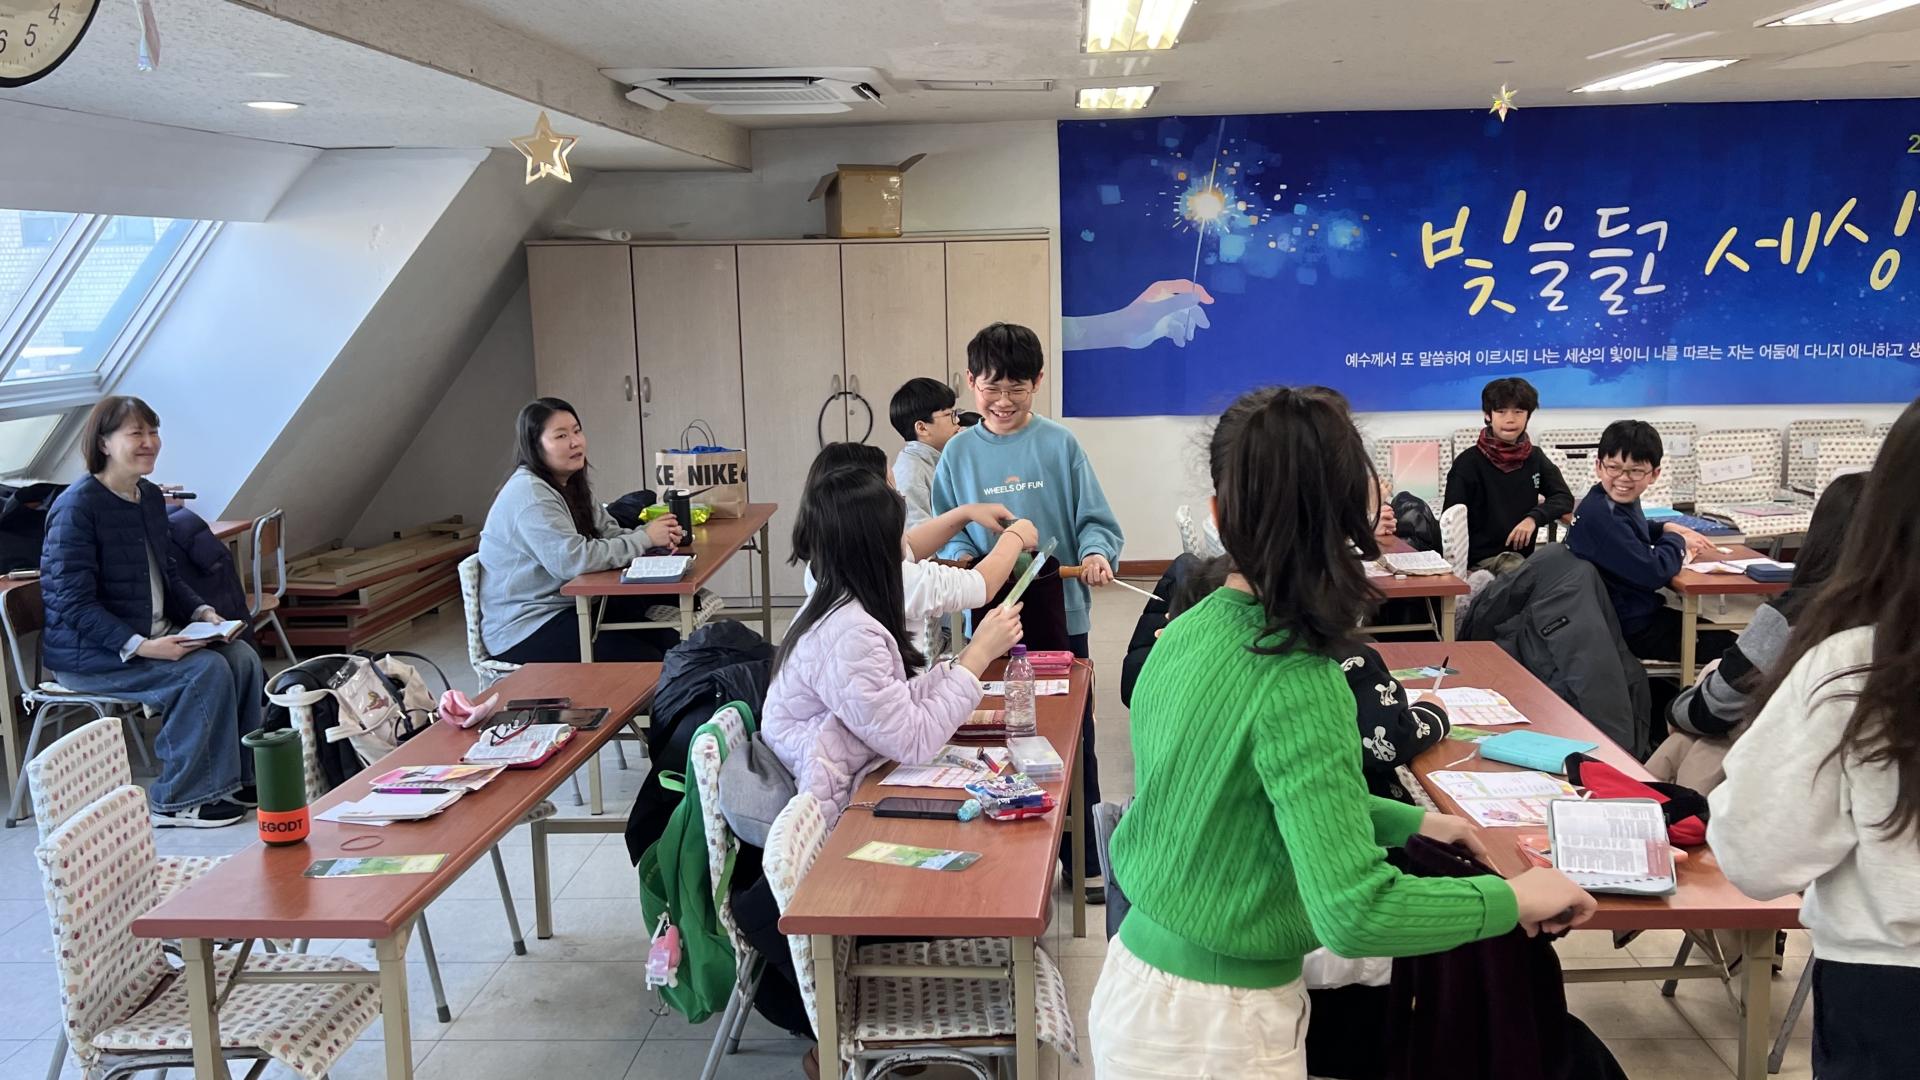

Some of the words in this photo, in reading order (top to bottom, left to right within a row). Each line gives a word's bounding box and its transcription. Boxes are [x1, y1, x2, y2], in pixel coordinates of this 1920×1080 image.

[48, 2, 60, 25] 4
[24, 23, 38, 47] 5
[1907, 134, 1920, 154] 2
[1345, 351, 1396, 368] 예수께서
[1400, 352, 1415, 367] 또
[1419, 350, 1471, 367] 말씀하여
[1475, 348, 1529, 366] 이르시되
[1533, 348, 1560, 364] 나는
[1564, 347, 1605, 364] 세상의
[1609, 346, 1650, 363] 빛이니
[1654, 345, 1678, 361] 나를
[1683, 344, 1723, 361] 따르는
[1727, 344, 1755, 360] 자는
[1759, 344, 1800, 360] 어둠에
[1804, 343, 1844, 359] 다니지
[1849, 342, 1904, 359] 아니하고
[687, 463, 738, 486] NIKE
[983, 484, 1015, 496] WHEELS
[1015, 483, 1026, 492] OF
[1028, 480, 1044, 490] FUN
[259, 818, 303, 833] LEGODT
